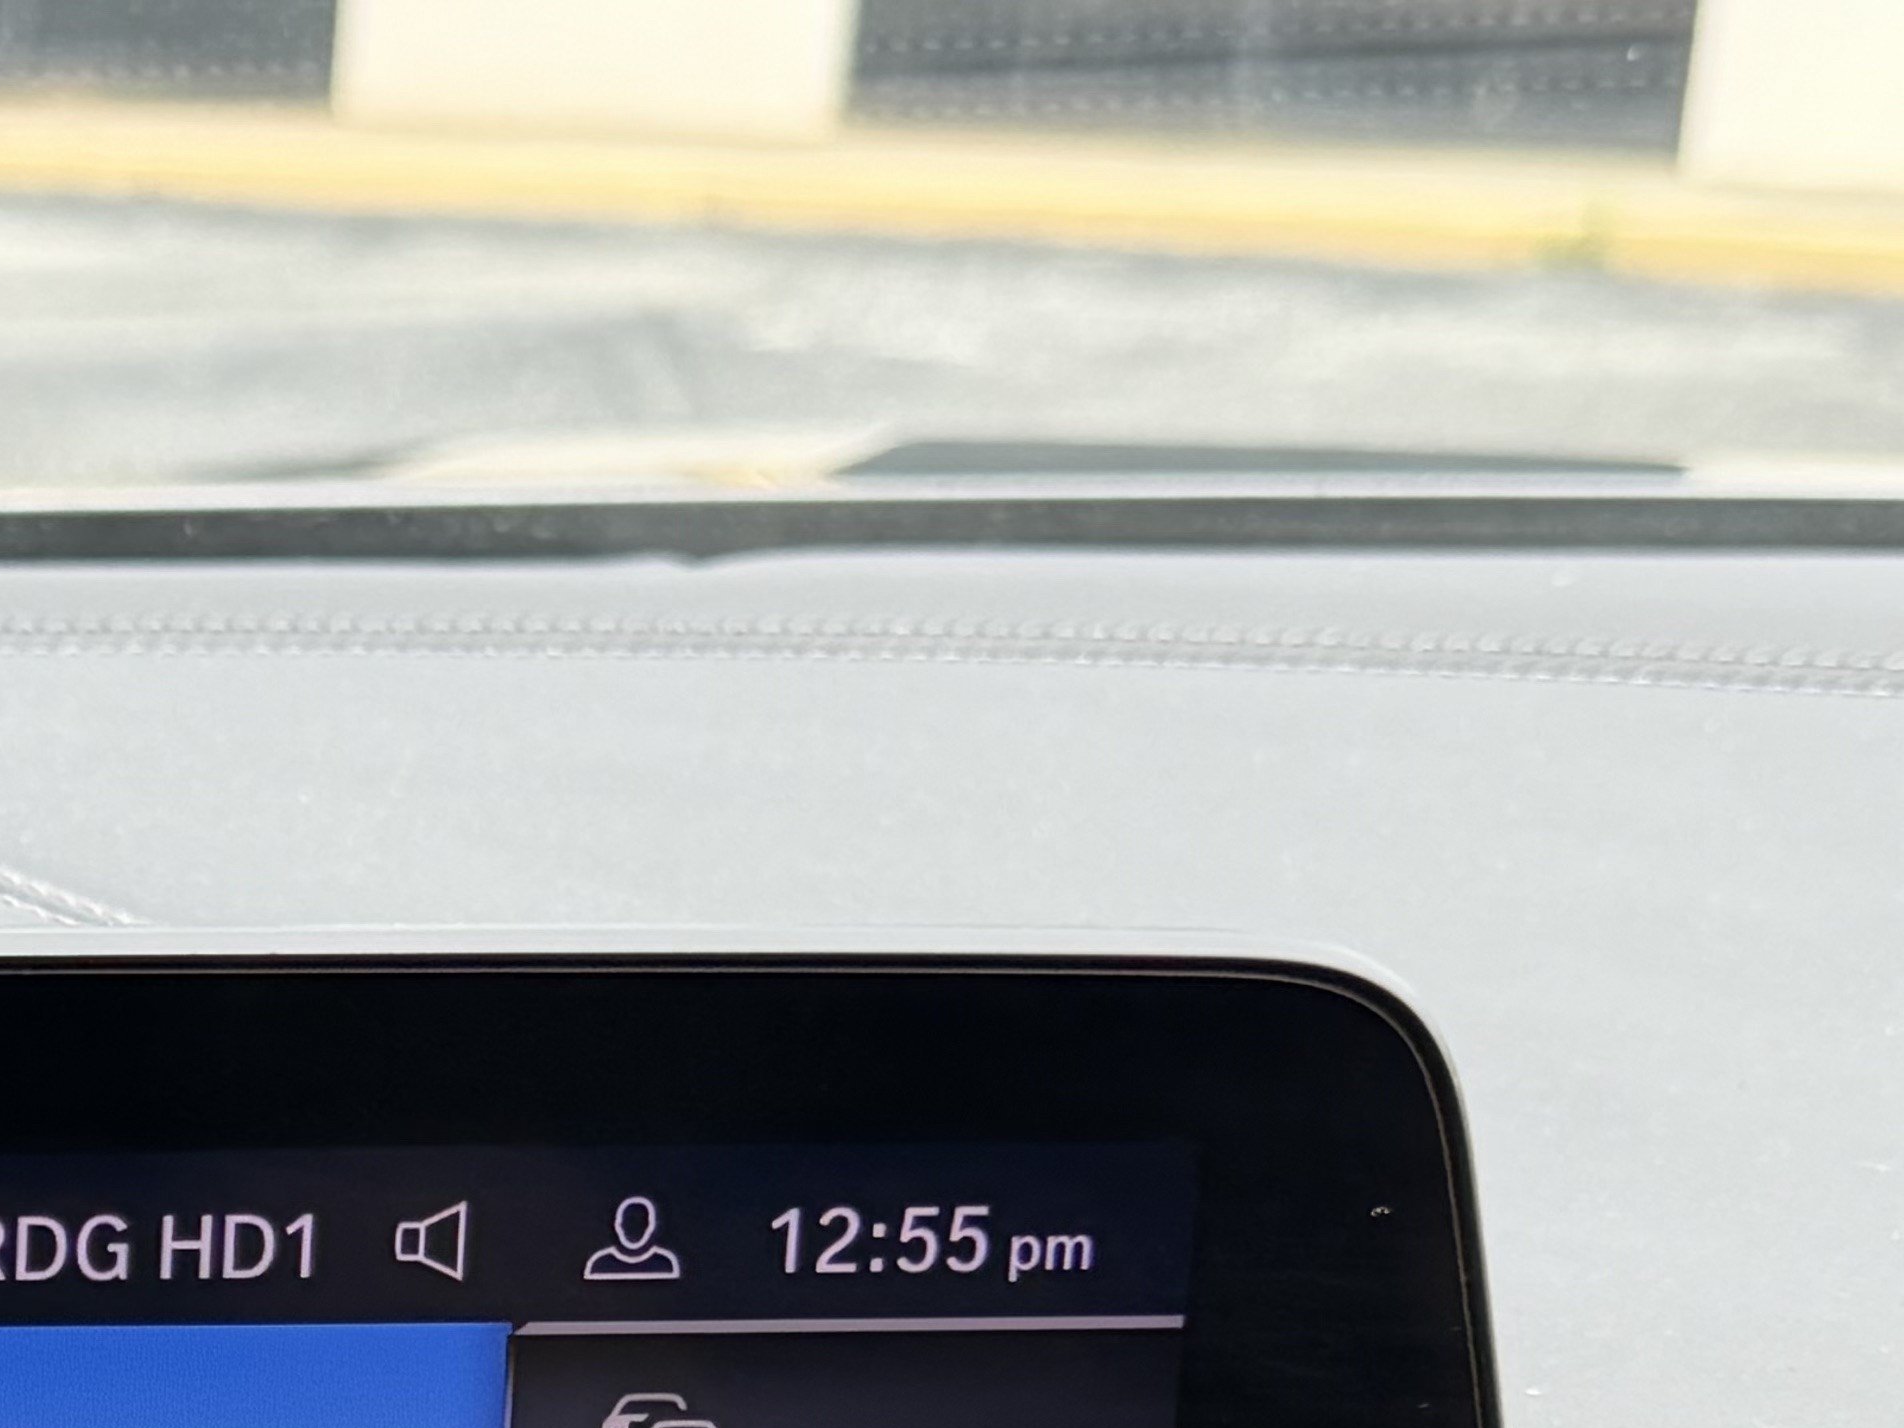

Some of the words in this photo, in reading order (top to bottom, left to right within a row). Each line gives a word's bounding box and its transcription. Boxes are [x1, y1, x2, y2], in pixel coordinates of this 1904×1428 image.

[159, 1213, 314, 1280] HD1
[771, 1205, 990, 1274] 12:55
[1008, 1234, 1094, 1283] pm
